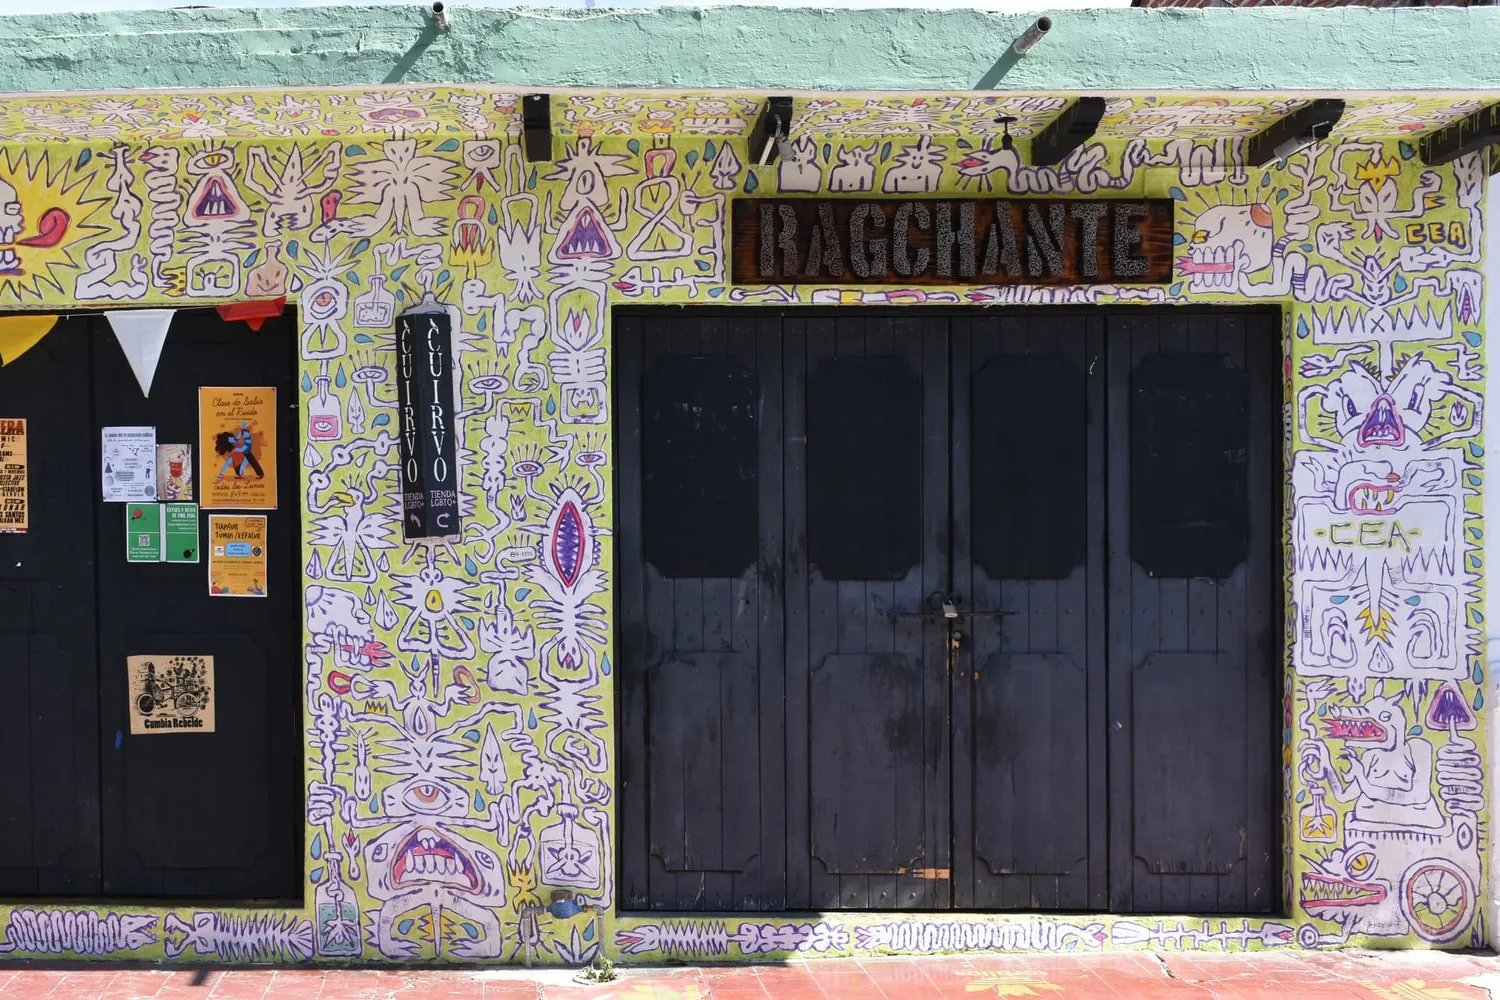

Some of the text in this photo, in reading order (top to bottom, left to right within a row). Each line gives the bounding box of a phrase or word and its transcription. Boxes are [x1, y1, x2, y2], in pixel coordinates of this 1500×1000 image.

[759, 201, 1150, 277] RAGCHANTE
[1405, 220, 1467, 249] CEA
[427, 318, 448, 482] CUIRVO
[430, 490, 456, 498] TIENDA
[430, 499, 456, 507] LGBTQ+
[144, 717, 203, 729] Cumbia Rebelde
